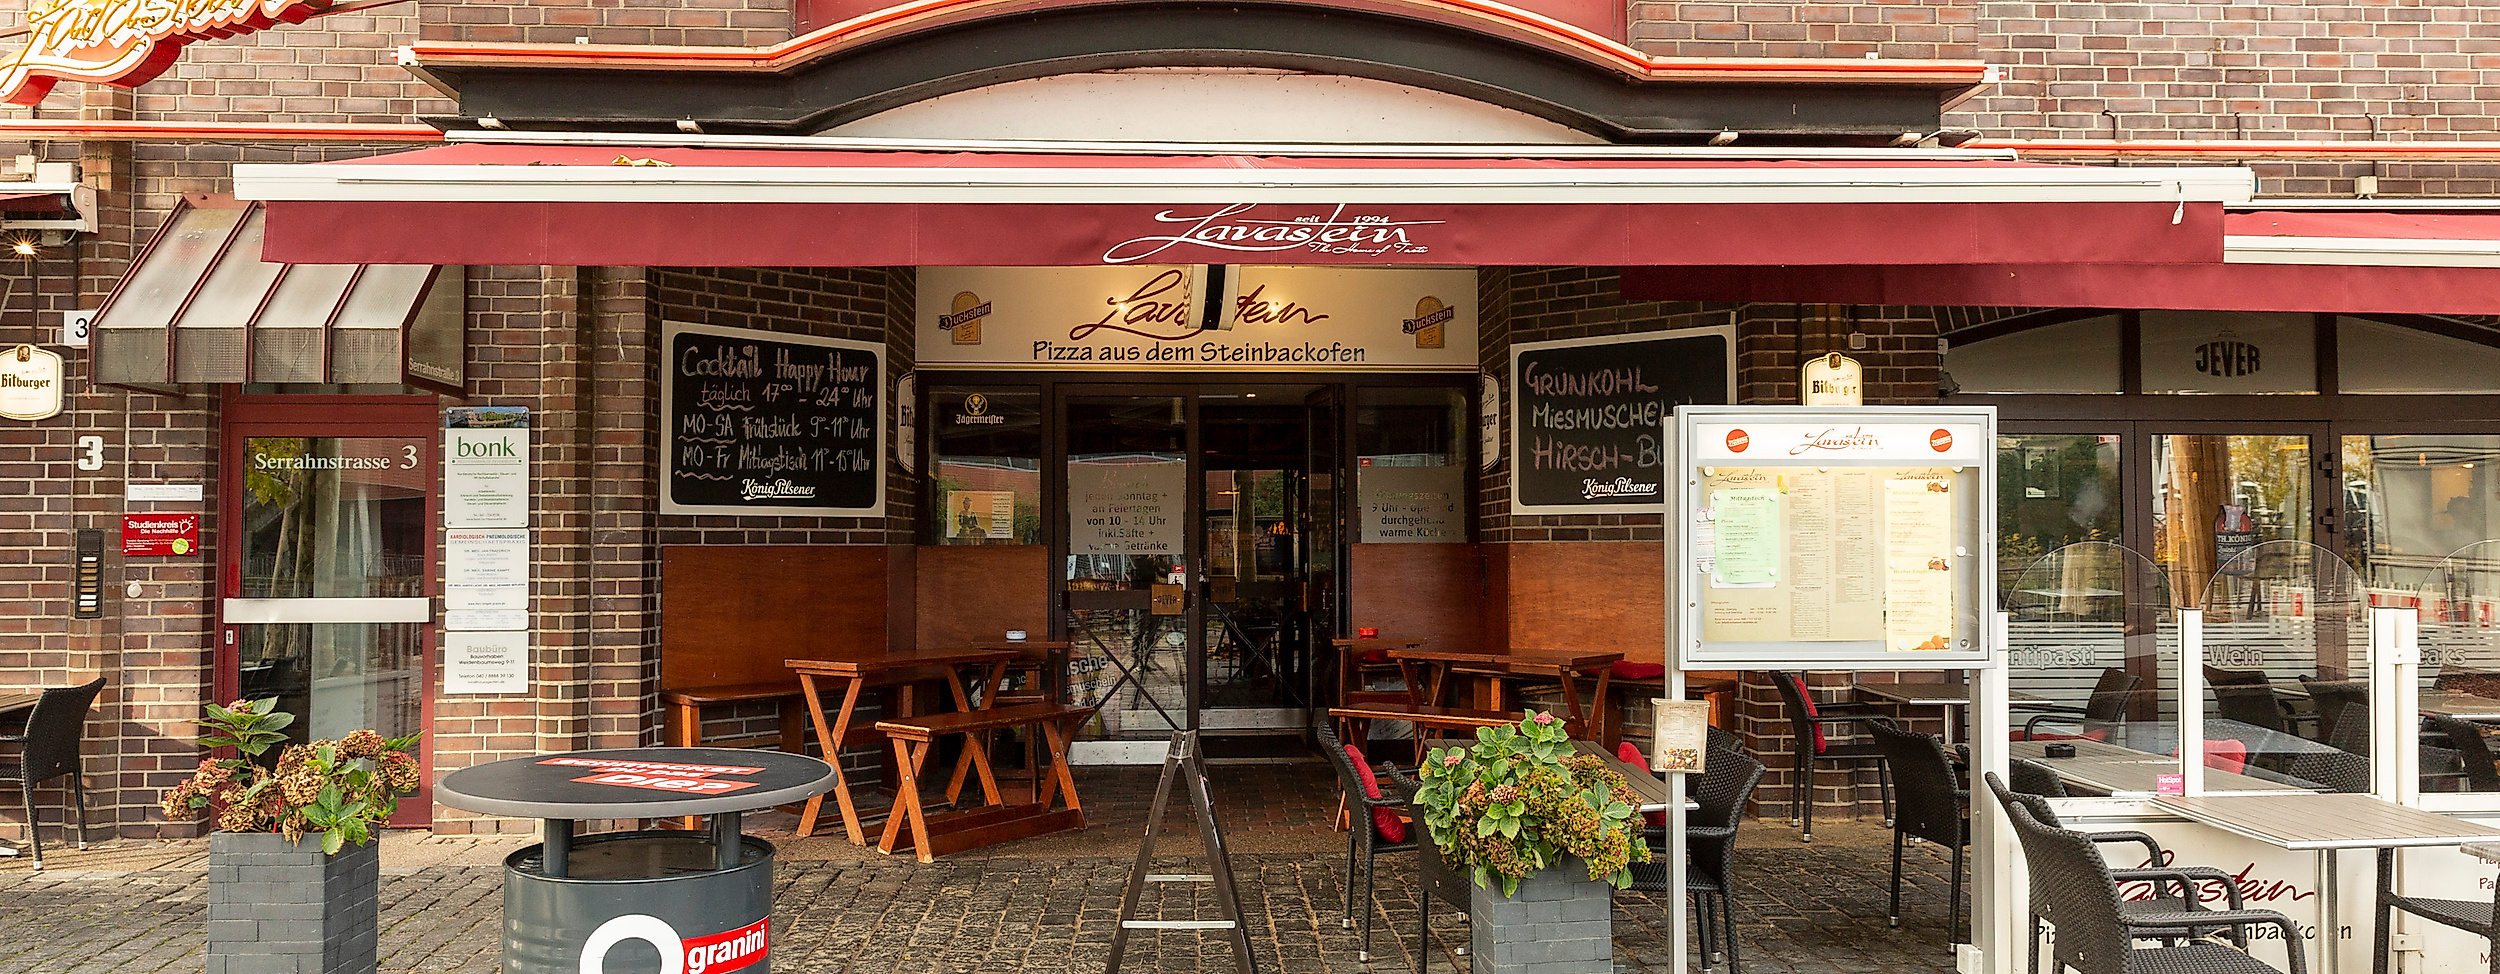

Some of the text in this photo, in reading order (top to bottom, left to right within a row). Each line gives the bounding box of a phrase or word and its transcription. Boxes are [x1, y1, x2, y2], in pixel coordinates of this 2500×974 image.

[1294, 215, 1390, 224] seit 1994
[1103, 203, 1430, 263] Lavastein
[1308, 242, 1331, 253] The
[1394, 242, 1429, 253] Taste
[939, 303, 991, 331] Duckstein
[1402, 308, 1453, 335] Duckstein
[75, 318, 89, 339] 3
[1033, 340, 1365, 362] Pizza aus dem Steinbackofen
[2194, 341, 2261, 377] JEVER
[409, 357, 460, 382] Serrahnstraße 3
[681, 345, 869, 393] Cocktail Happy Hour
[0, 373, 51, 390] Bitburger
[701, 381, 751, 407] täglich
[852, 388, 873, 409] Uhr
[682, 413, 734, 436] MO-SA
[742, 413, 801, 440] Frühstück
[850, 417, 871, 440] Uhr
[955, 414, 1005, 425] Jägermeister
[457, 435, 516, 457] bonk
[1789, 426, 1880, 456] Lavastein
[78, 435, 104, 471] 3
[254, 444, 418, 470] Serrahnstrasse 3
[682, 445, 731, 469] MO-Fr
[738, 443, 808, 479] Mittagstisch
[853, 448, 871, 472] Uhr
[741, 478, 816, 498] König Pilsener
[1117, 492, 1158, 502] onntag
[1582, 477, 1658, 497] König Pilsener
[1092, 503, 1161, 514] an Feiertagen
[127, 520, 179, 529] Studienkreis
[1086, 517, 1105, 525] von
[1109, 516, 1121, 525] 10
[1149, 515, 1166, 526] Uhr
[1380, 529, 1413, 537] warme
[466, 644, 508, 653] Baubüro
[2008, 644, 2096, 670] ntipasti
[2208, 644, 2264, 666] Wein
[2419, 643, 2466, 665] eaks
[687, 923, 766, 974] granini
